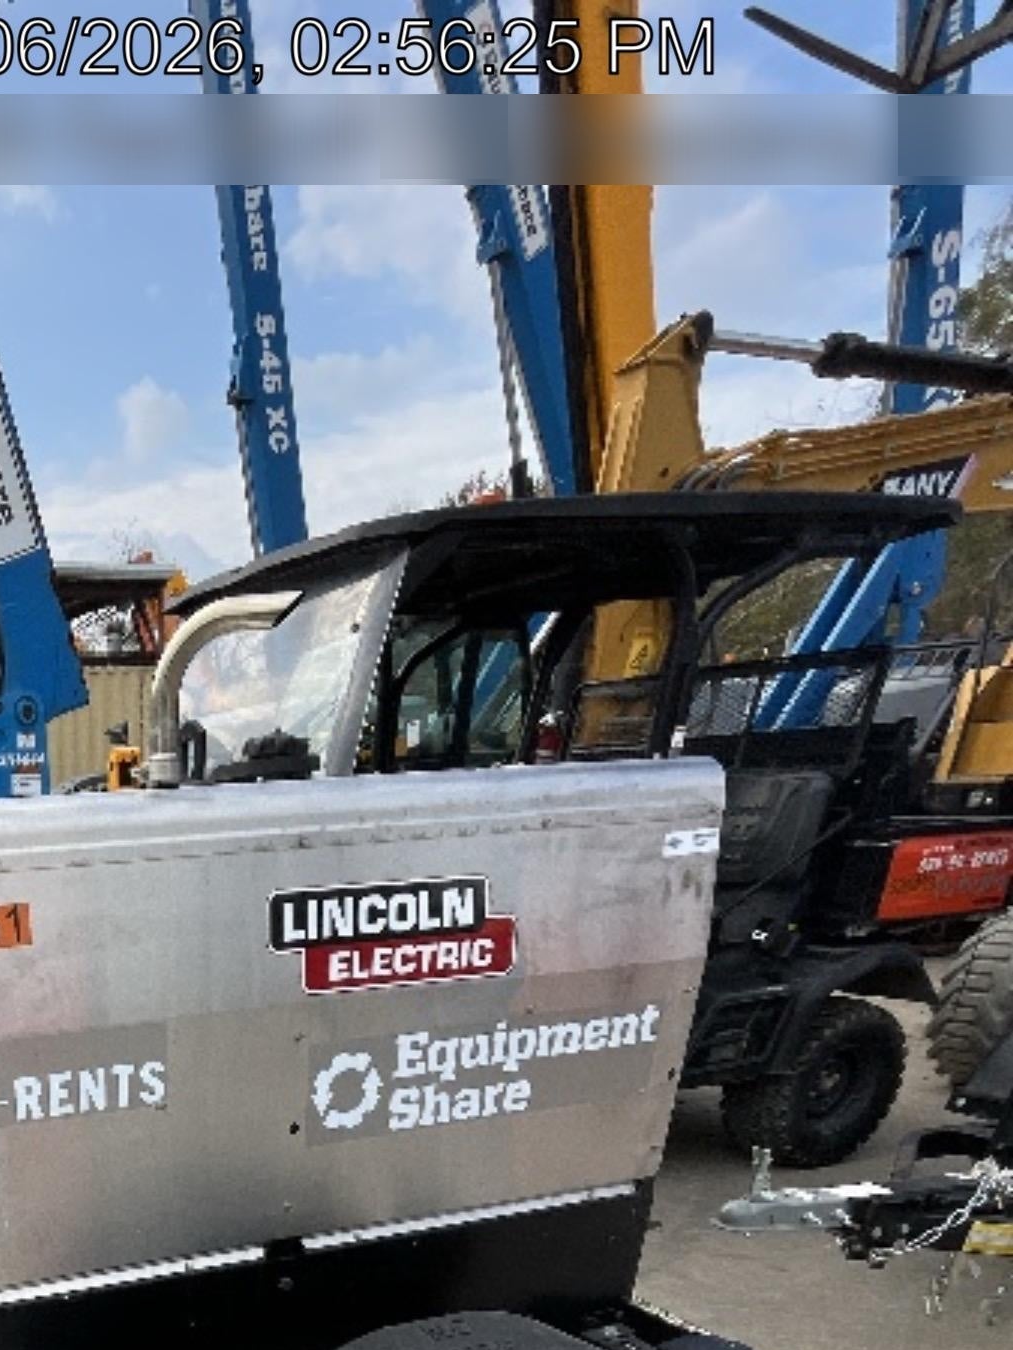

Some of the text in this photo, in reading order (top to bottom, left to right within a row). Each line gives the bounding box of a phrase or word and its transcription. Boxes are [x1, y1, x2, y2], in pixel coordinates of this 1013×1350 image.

[925, 230, 961, 350] S-65
[255, 311, 290, 454] S-45 XC
[283, 887, 475, 943] LINCOLN
[328, 938, 496, 982] ELECTRIC
[392, 1004, 662, 1081] Equipment
[388, 1079, 533, 1132] Share
